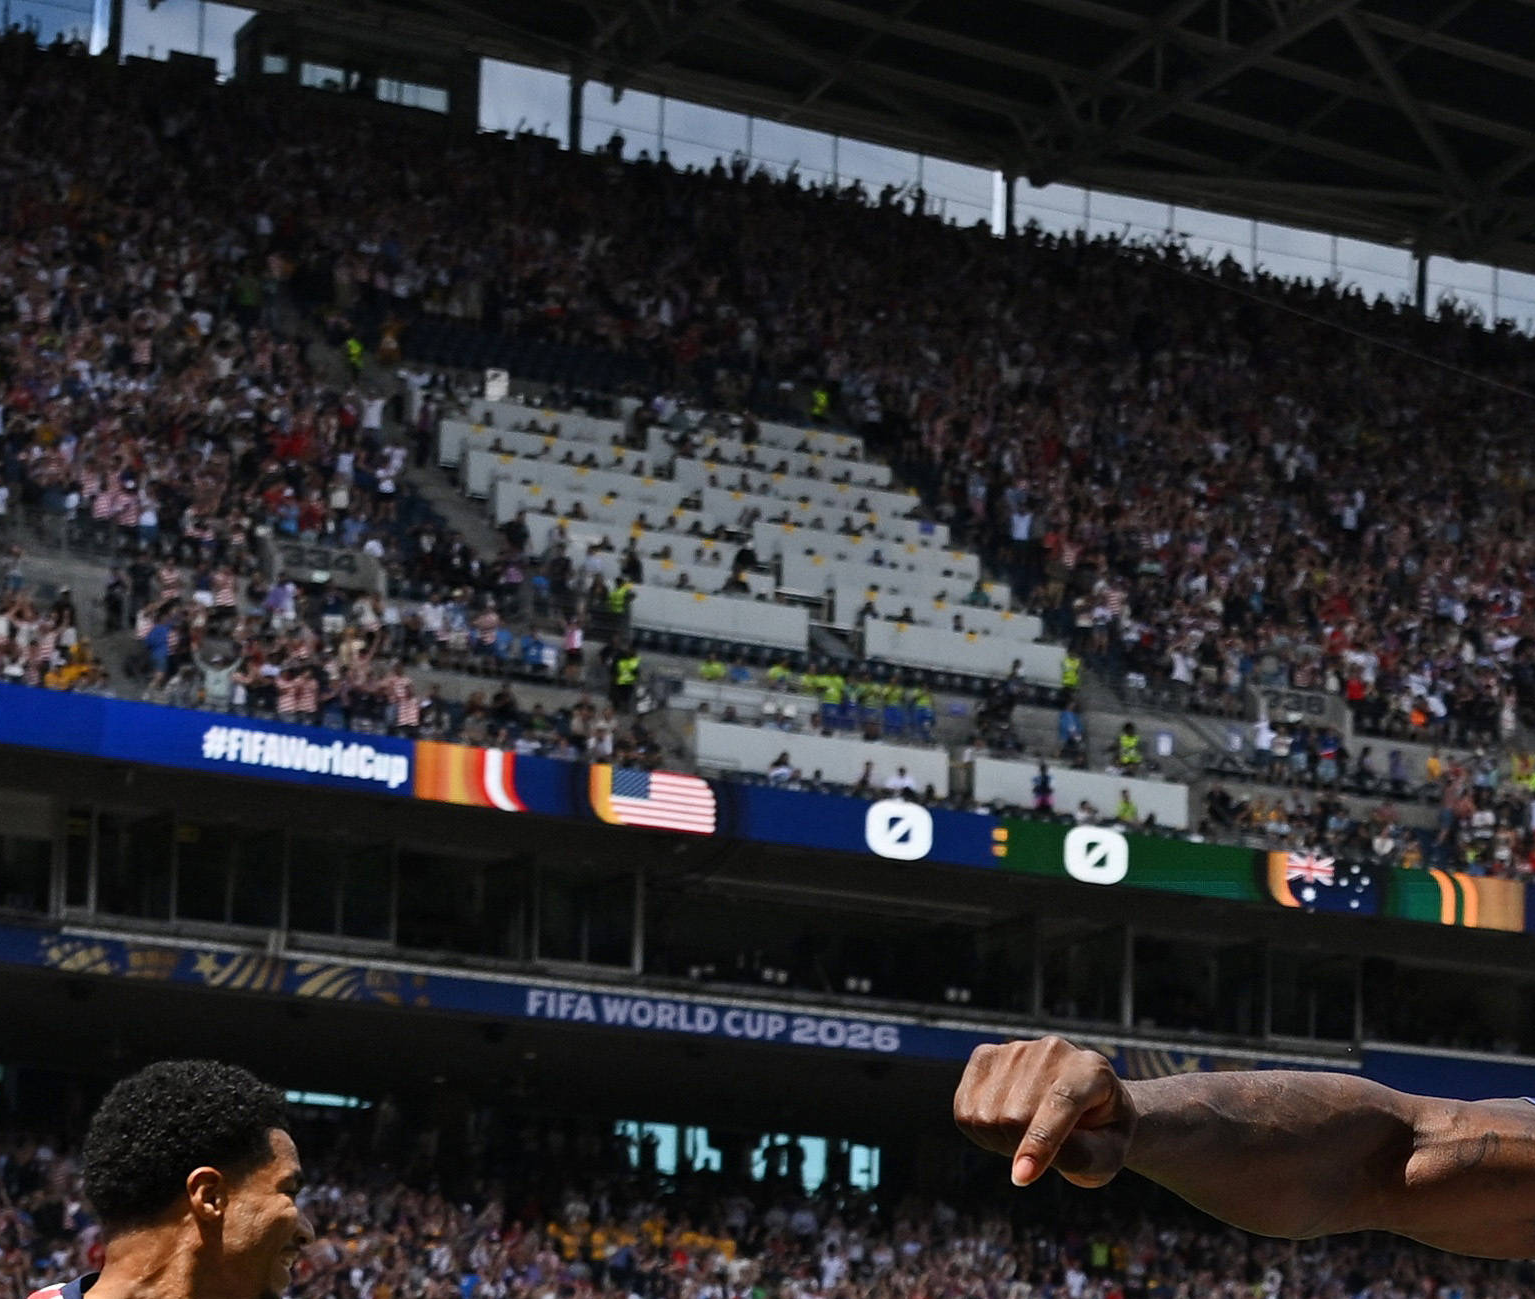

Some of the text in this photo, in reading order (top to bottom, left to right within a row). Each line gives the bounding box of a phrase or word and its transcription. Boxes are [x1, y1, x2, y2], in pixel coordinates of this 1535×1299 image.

[202, 726, 409, 789] #FIFAWorldCup
[526, 989, 901, 1053] FIFA WORLD CUP 2026
